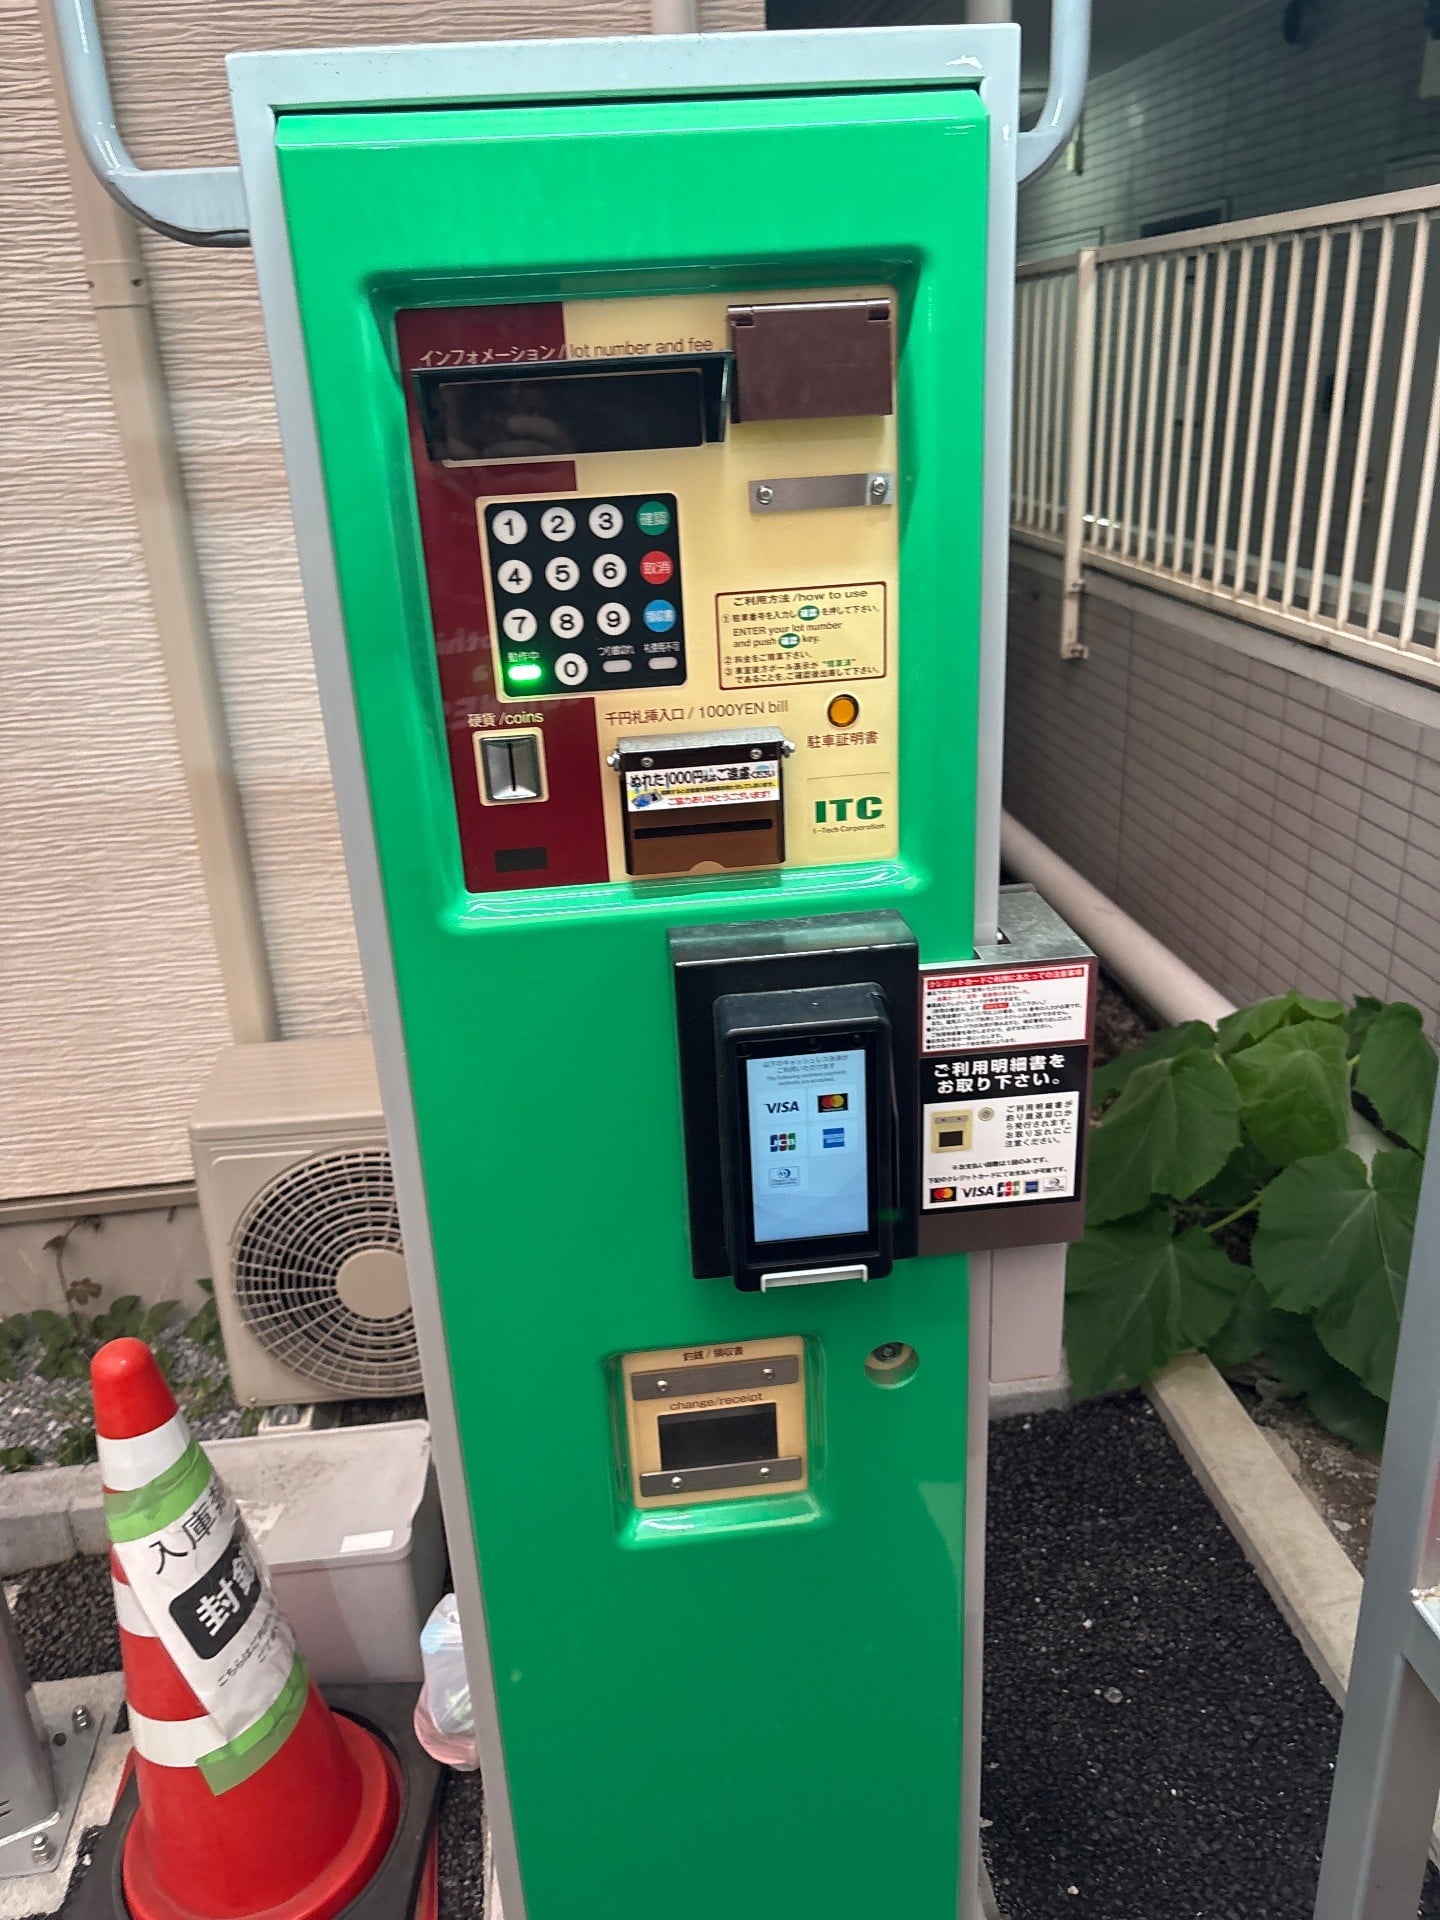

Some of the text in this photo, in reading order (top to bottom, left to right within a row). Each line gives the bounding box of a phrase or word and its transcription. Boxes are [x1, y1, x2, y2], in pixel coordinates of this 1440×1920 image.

[419, 345, 556, 367] インフォメーション
[594, 340, 651, 357] number
[655, 338, 683, 354] and
[688, 337, 713, 351] fee
[503, 518, 515, 537] 1
[550, 515, 566, 534] 2
[599, 512, 614, 530] 3
[508, 568, 523, 586] 4
[555, 564, 571, 583] 5
[602, 561, 618, 580] 6
[733, 594, 791, 607] ご利用方法
[829, 589, 842, 600] to
[844, 588, 868, 598] use
[511, 616, 528, 634] 7
[560, 613, 575, 631] 8
[606, 609, 621, 628] 9
[732, 627, 767, 637] ENTER
[806, 621, 843, 631] number
[604, 708, 685, 726] 千円札挿入口
[699, 702, 765, 719] 1000YEN
[768, 700, 789, 714] bill
[807, 731, 880, 750] 駐車証明書
[814, 796, 884, 824] ITC
[934, 1054, 1065, 1078] ご利用明細書を
[937, 1073, 1061, 1094] お取り下さい。
[765, 1101, 800, 1114] VISA
[961, 1186, 994, 1198] VISA
[669, 1392, 763, 1411] change/receipt
